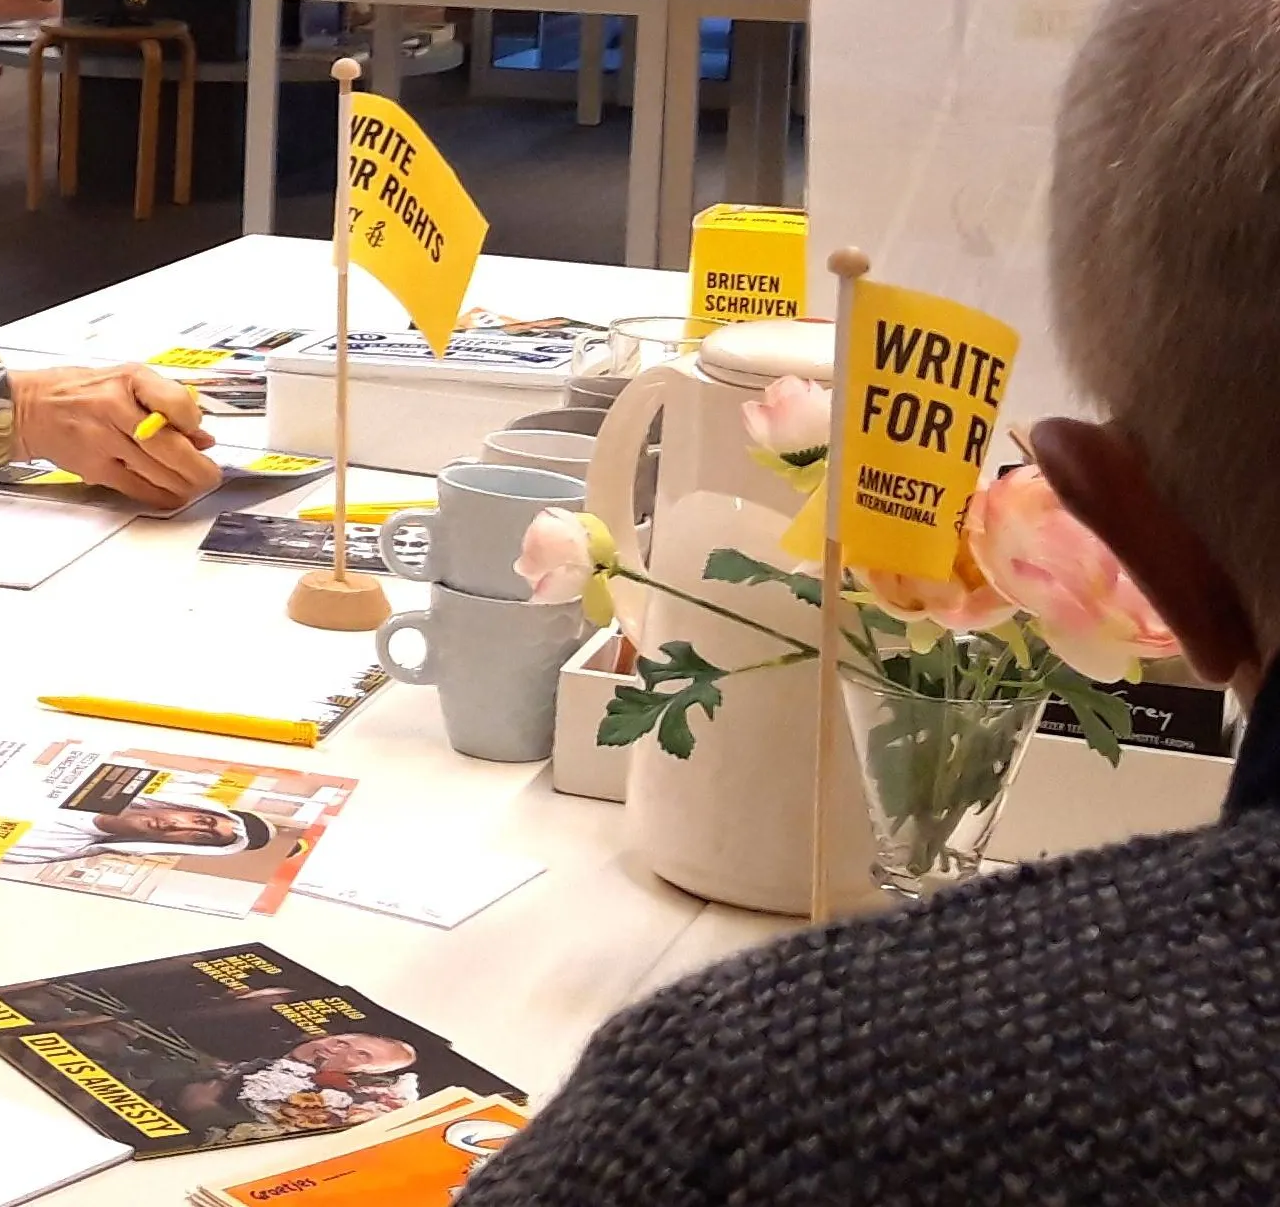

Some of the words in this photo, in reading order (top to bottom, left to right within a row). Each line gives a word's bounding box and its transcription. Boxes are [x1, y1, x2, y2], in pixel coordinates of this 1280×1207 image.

[379, 173, 445, 263] RIGHTS
[707, 271, 781, 293] BRIEVEN
[705, 294, 799, 318] SCHRIJVEN
[875, 319, 1006, 408] WRITE
[862, 384, 954, 454] FOR
[857, 464, 946, 508] AMNESTY
[856, 490, 938, 528] INTERNATIONAL
[208, 958, 251, 980] TEGEN
[271, 1003, 328, 1036] ONRECHT
[289, 1001, 331, 1024] TEGEN
[27, 1035, 78, 1058] DIT
[58, 1059, 97, 1075] IS
[78, 1077, 182, 1134] AMNESTY
[249, 1176, 317, 1201] Groetjes
